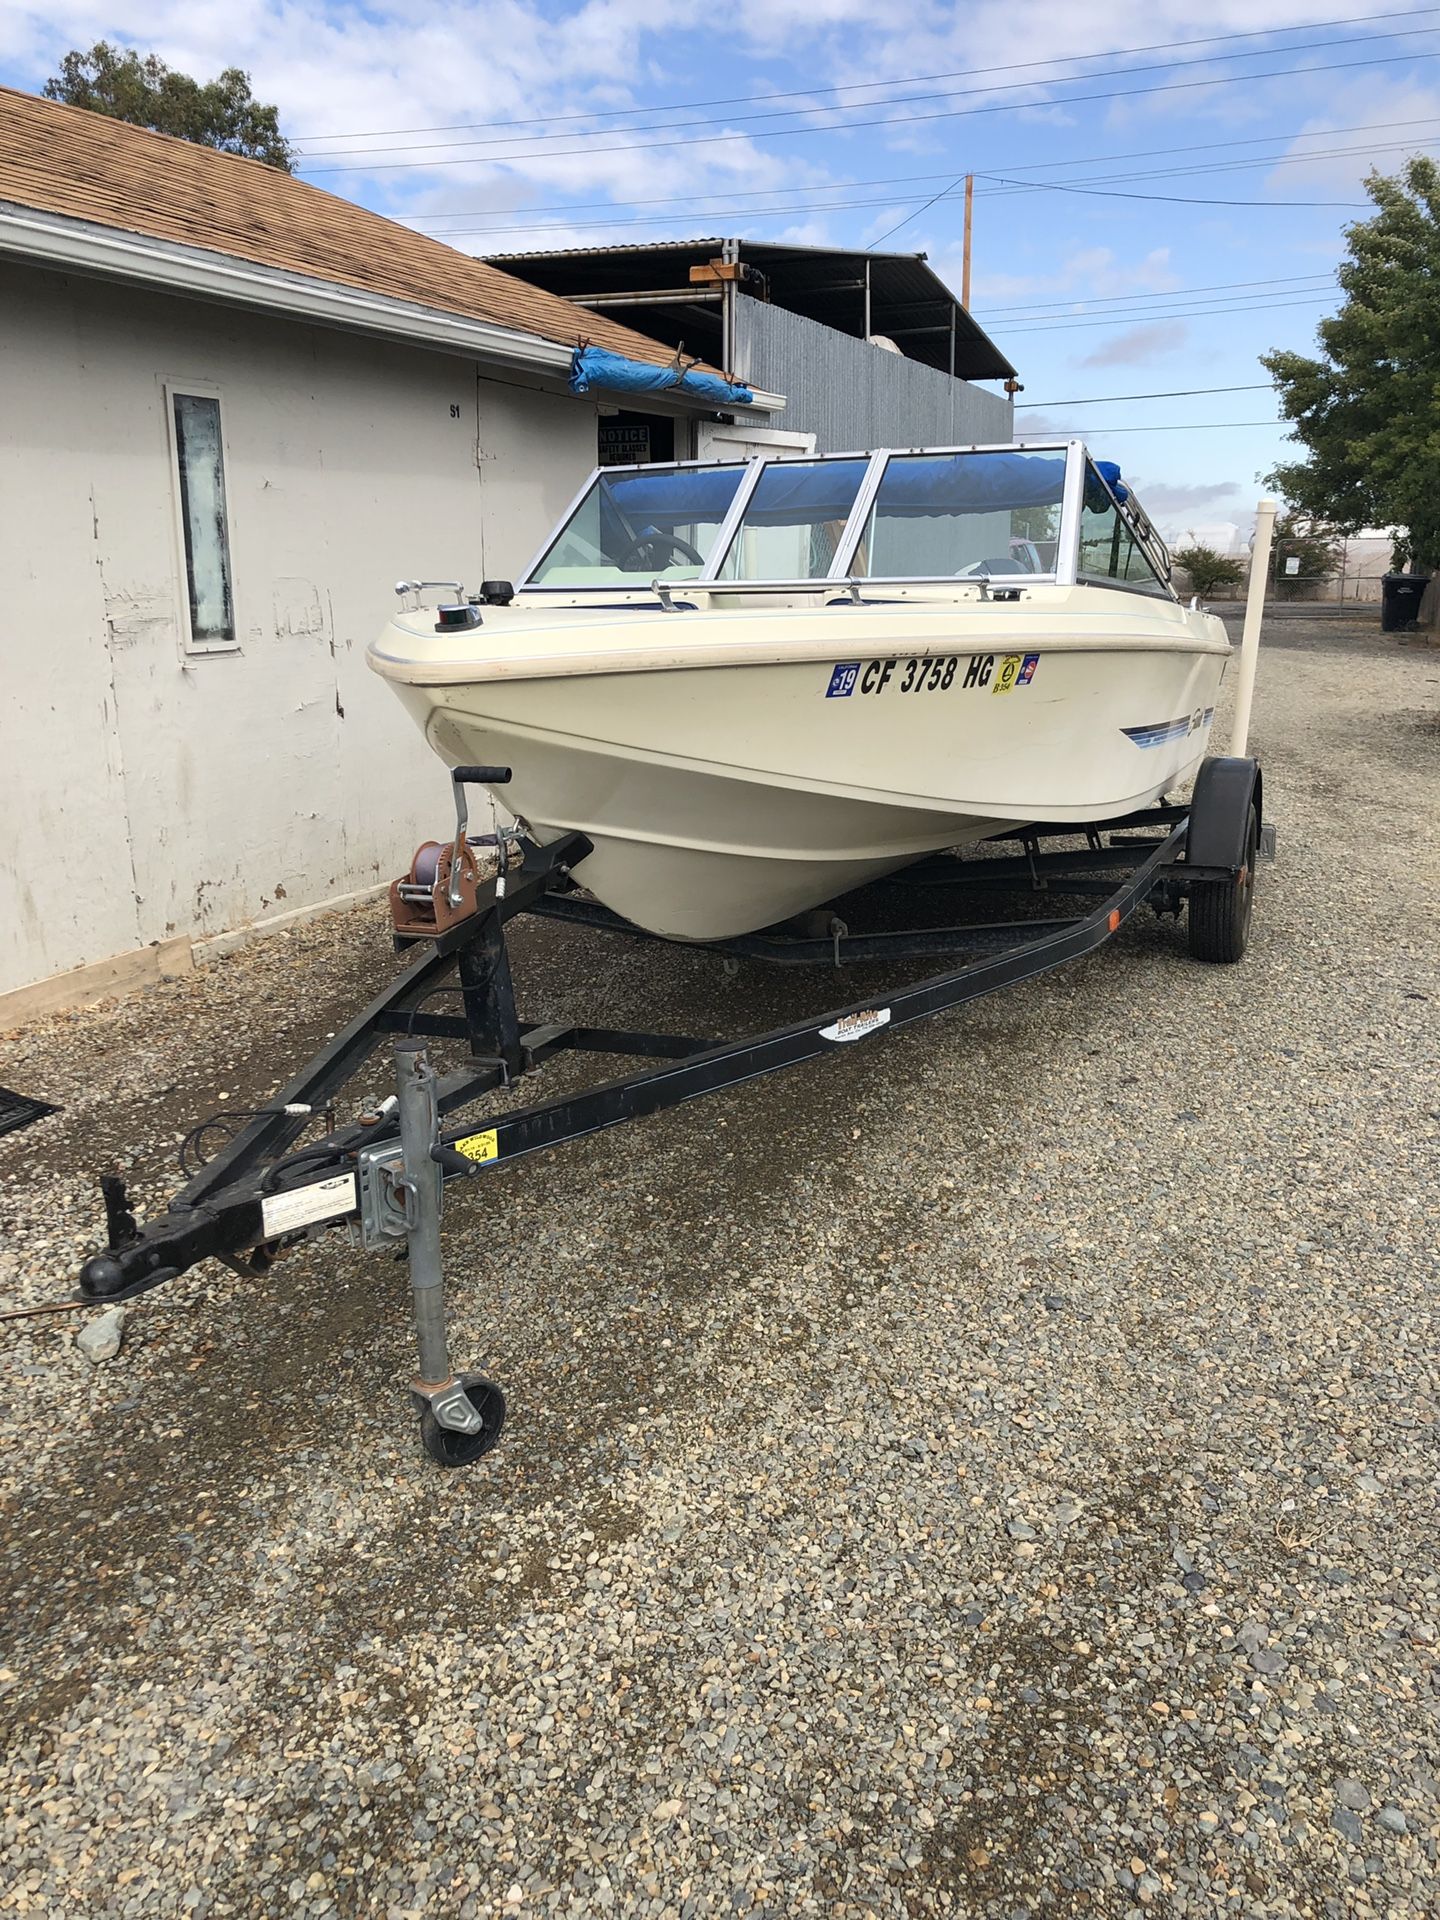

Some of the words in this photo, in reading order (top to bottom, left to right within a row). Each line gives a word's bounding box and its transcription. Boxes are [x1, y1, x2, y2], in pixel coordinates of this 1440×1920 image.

[599, 429, 647, 442] NOTICE
[621, 443, 647, 452] GLASSES
[609, 453, 637, 461] REQUIRED
[839, 669, 857, 690] 19
[861, 660, 897, 694] CF
[900, 657, 958, 692] 3758
[962, 655, 994, 688] HG
[853, 1018, 879, 1030] TRAILERS
[467, 1147, 488, 1160] 354
